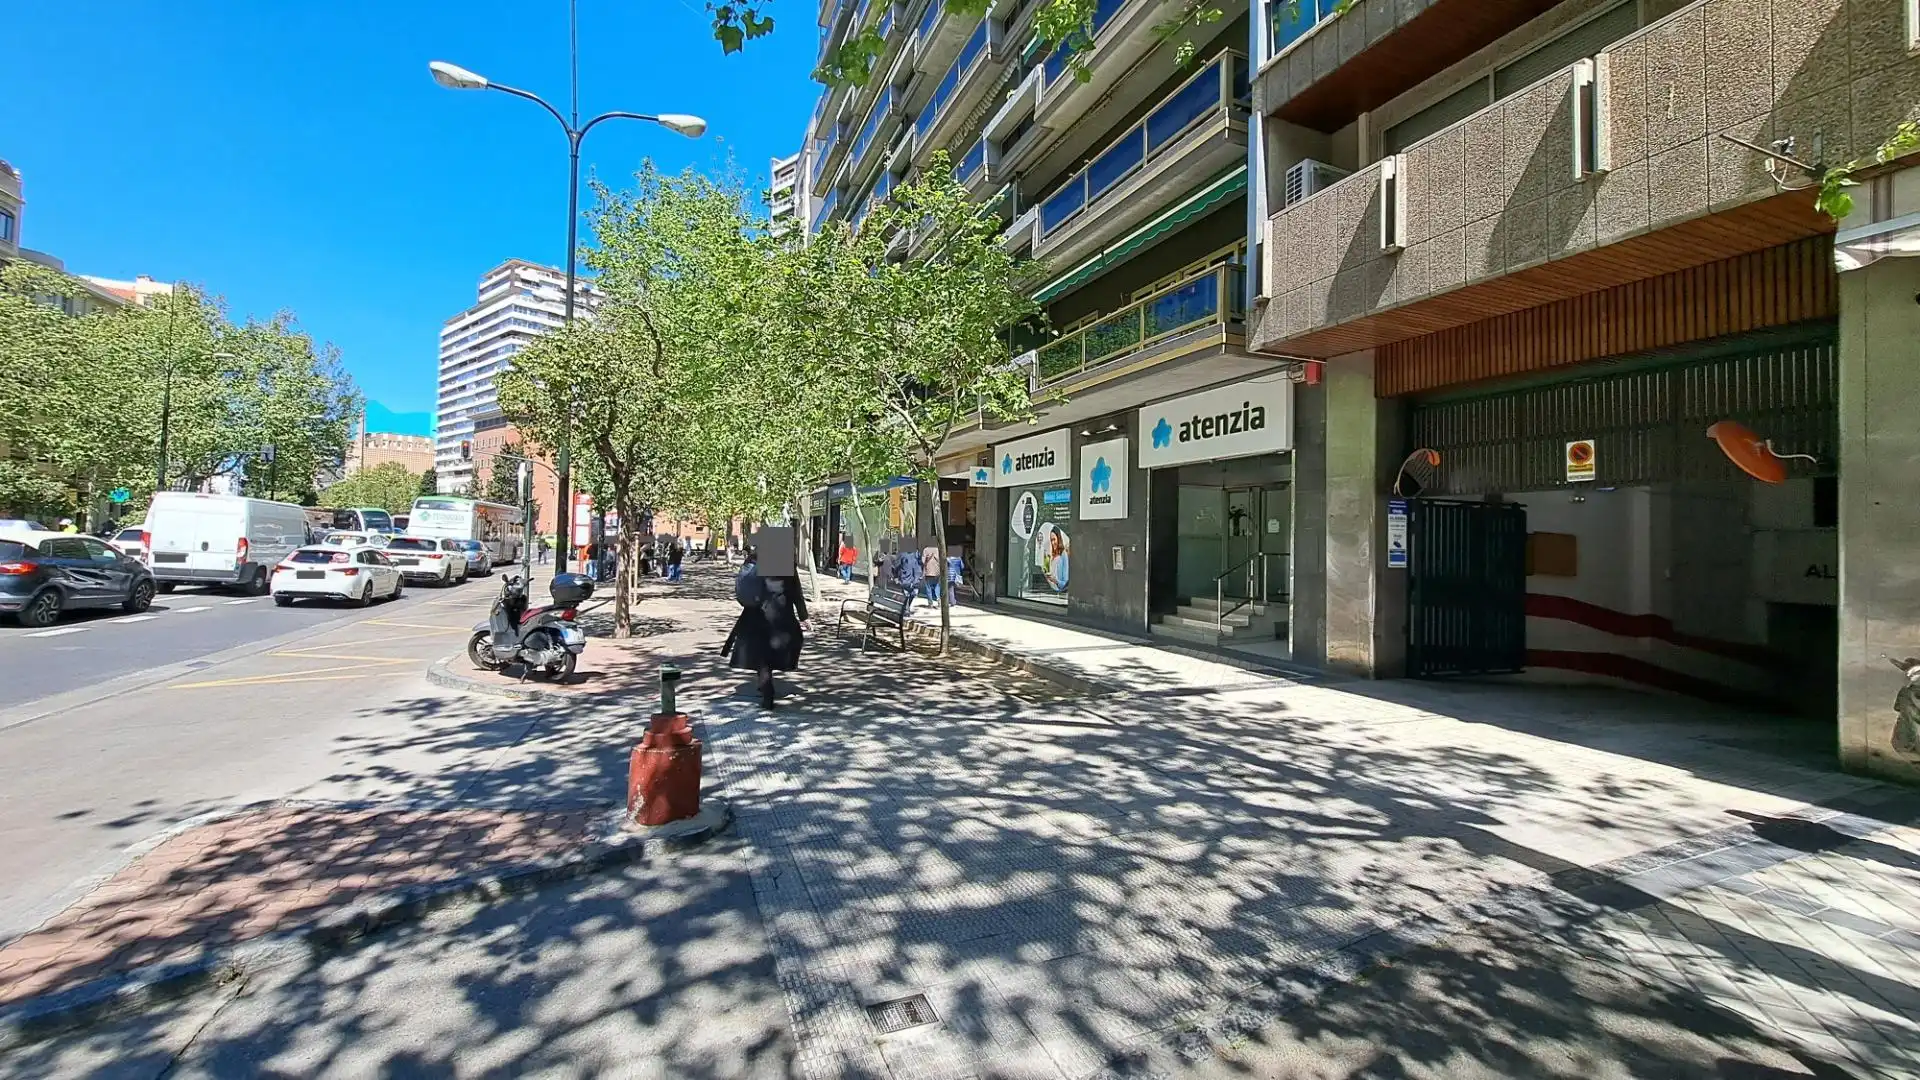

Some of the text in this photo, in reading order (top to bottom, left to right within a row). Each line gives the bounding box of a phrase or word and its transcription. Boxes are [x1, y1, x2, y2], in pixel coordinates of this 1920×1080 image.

[1179, 401, 1265, 443] atenzia
[1015, 446, 1055, 471] atenzia
[1089, 493, 1111, 505] atenzia
